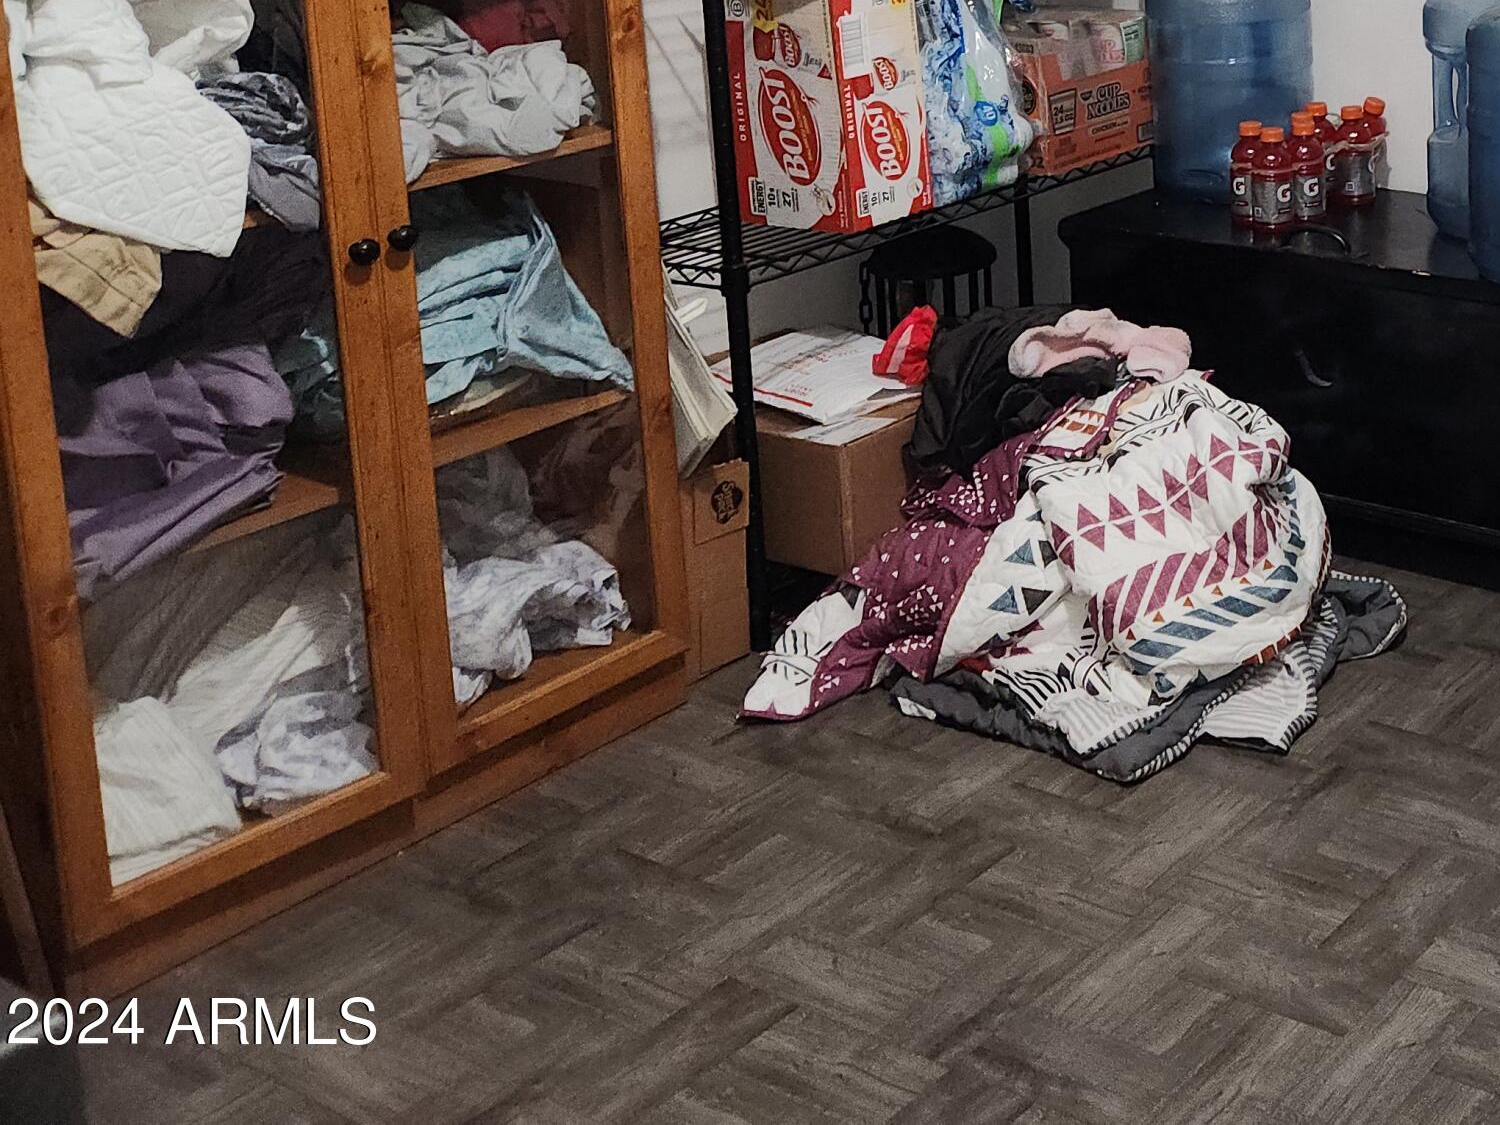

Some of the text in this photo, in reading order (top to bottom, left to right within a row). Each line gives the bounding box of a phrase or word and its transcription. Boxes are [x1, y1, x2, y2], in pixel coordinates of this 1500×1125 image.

[784, 25, 797, 66] BOOST
[876, 59, 894, 91] BOOST
[1096, 81, 1121, 101] CUP
[734, 72, 747, 142] ORIGINAL
[844, 84, 855, 139] ORIGINAL
[1053, 104, 1064, 115] 24
[1086, 92, 1130, 120] NOODLES
[765, 72, 811, 179] BOOST
[864, 103, 902, 177] BOOST
[755, 180, 766, 213] ENERGY
[1232, 177, 1246, 195] G
[1276, 183, 1291, 202] G
[1303, 177, 1319, 197] G
